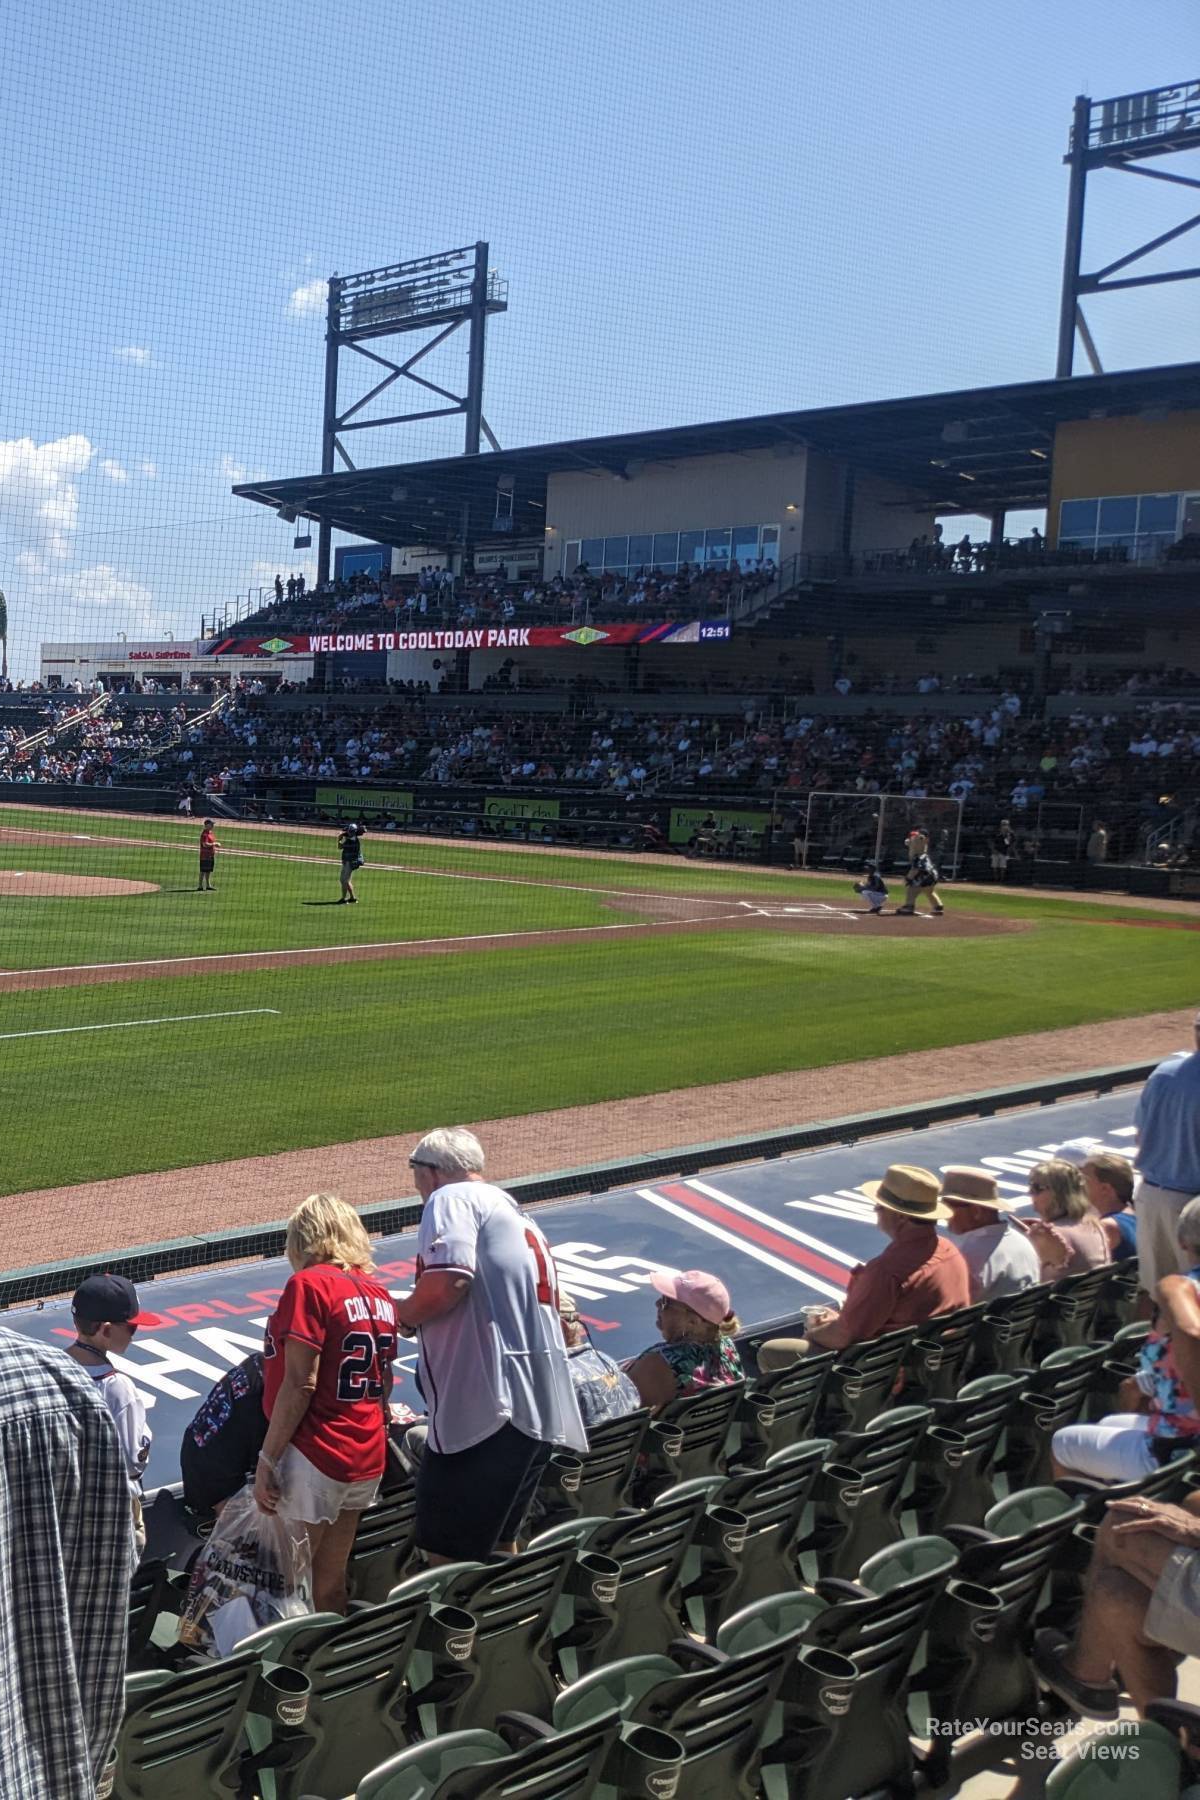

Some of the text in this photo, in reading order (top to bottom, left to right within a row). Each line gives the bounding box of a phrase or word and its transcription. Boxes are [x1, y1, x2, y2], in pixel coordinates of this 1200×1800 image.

[309, 634, 373, 651] WELCOME
[377, 633, 394, 650] TO
[399, 630, 484, 650] COOLTODAY
[488, 628, 530, 647] PARK
[701, 627, 729, 638] 12:51
